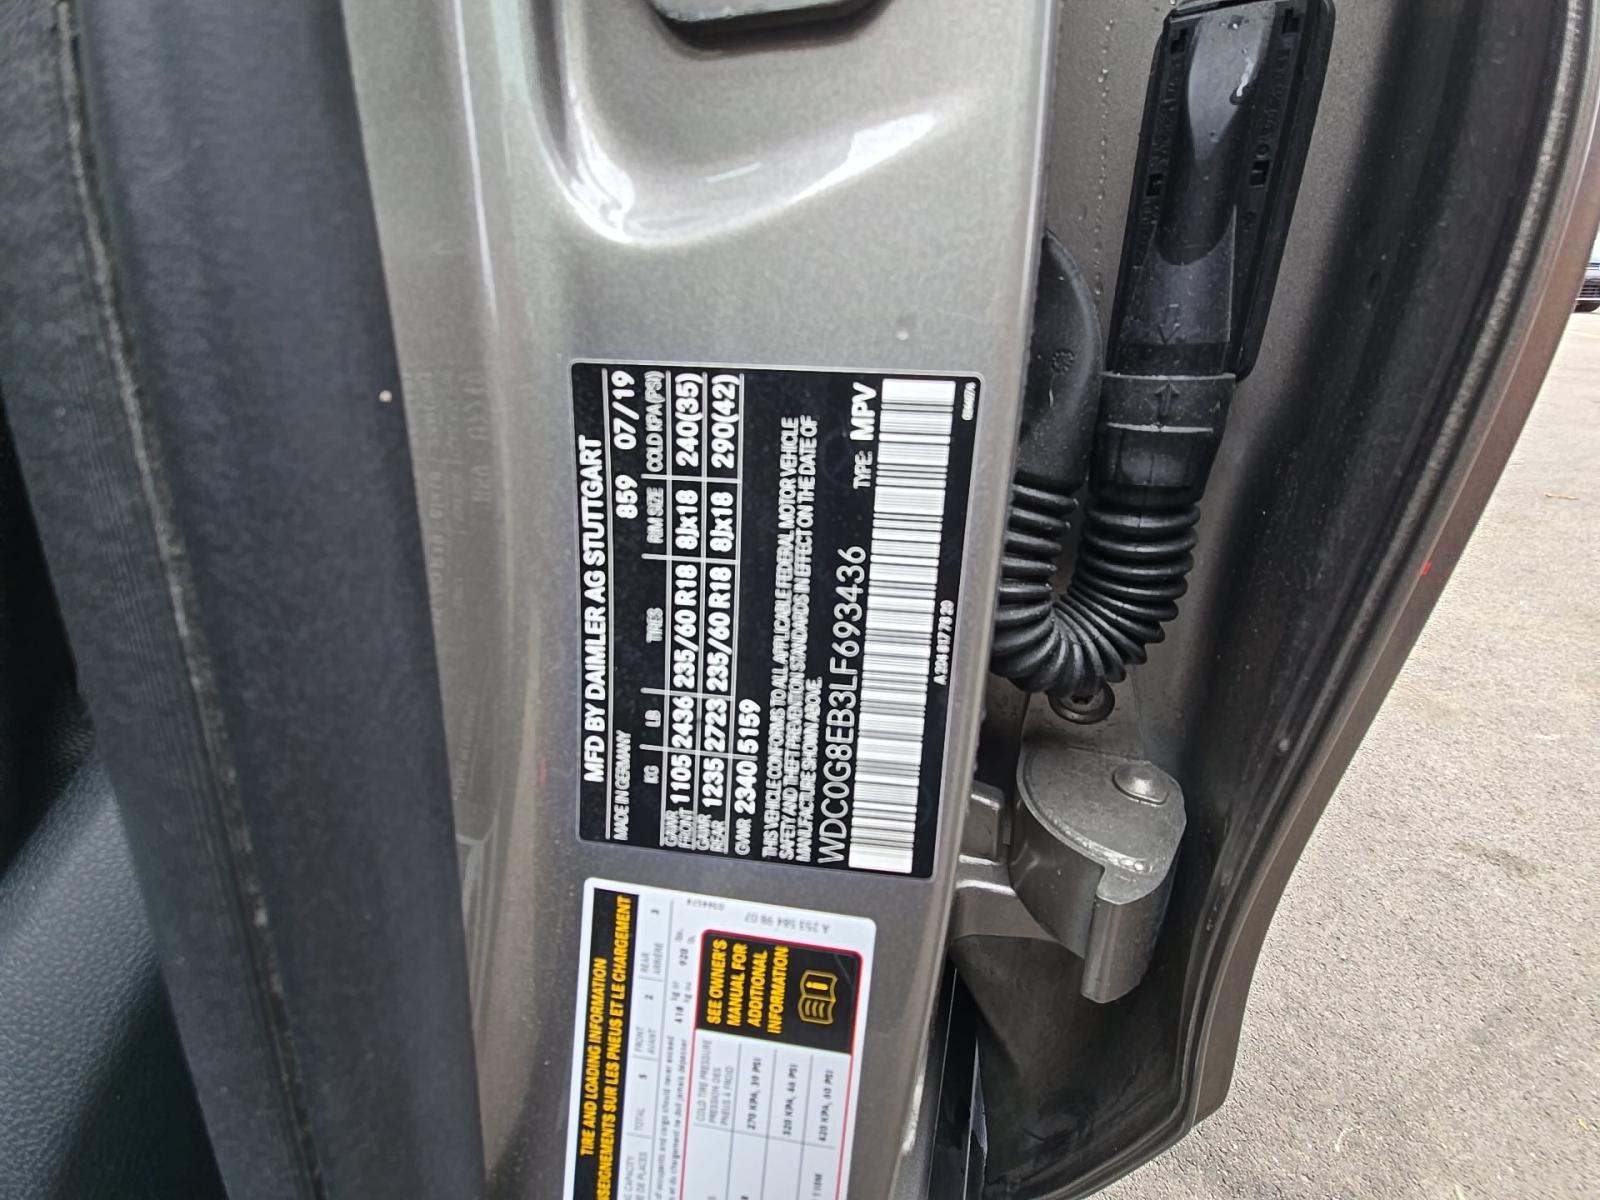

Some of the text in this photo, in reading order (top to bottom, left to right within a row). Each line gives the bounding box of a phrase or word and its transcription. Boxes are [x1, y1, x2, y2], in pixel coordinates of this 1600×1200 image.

[611, 370, 640, 519] 859 07/19
[674, 373, 703, 467] 240(35)
[710, 374, 740, 468] 290(42)
[850, 382, 877, 490] TYPE: MPV
[646, 433, 663, 472] COLD
[646, 487, 663, 544] RIM SIZE
[675, 490, 700, 550] 8Jx18
[710, 492, 734, 551] 8Jx18
[578, 435, 606, 782] MFD BY DAIMLER AG STUTTGART
[646, 608, 663, 643] TIRES
[672, 564, 699, 688] 235/60 R18
[706, 567, 732, 692] 235/60 R18
[762, 417, 799, 858] THIS VEHICLE CONFORMS TO ALL APPLICABLE FEDERAL MOTOR VEHICLE
[779, 415, 818, 860] SAFETY AND THEFT PREVENTION STANDARDS IN EFFECT ON THE DATE OF
[817, 546, 866, 862] WDC0G8EB3LF693436
[933, 675, 948, 686] A
[645, 710, 660, 727] LB
[671, 696, 694, 749] 2436
[704, 700, 727, 751] 2723
[737, 699, 761, 754] 5159
[614, 730, 631, 840] MADE IN GERMANY
[644, 765, 659, 784] KG
[670, 754, 692, 804] 1105
[702, 758, 724, 807] 1235
[734, 760, 758, 815] 2340
[796, 677, 823, 862] MANUFACTURE SHOWN ABOVE.
[678, 807, 694, 848] FRONT
[711, 820, 725, 852] REAR
[612, 895, 631, 982] CHARGEMENT
[610, 1000, 624, 1016] ET
[611, 983, 626, 1000] LE
[706, 939, 728, 1024] SEE OWNER'S
[726, 942, 748, 1026] MANUAL FOR
[746, 950, 768, 1027] ADDITIONAL
[766, 946, 790, 1034] INFORMATION
[580, 958, 607, 1156] TIRE AND LOADING INFORMATION
[606, 1018, 623, 1060] PNEUS
[602, 1086, 618, 1112] SUR
[604, 1062, 620, 1084] LES
